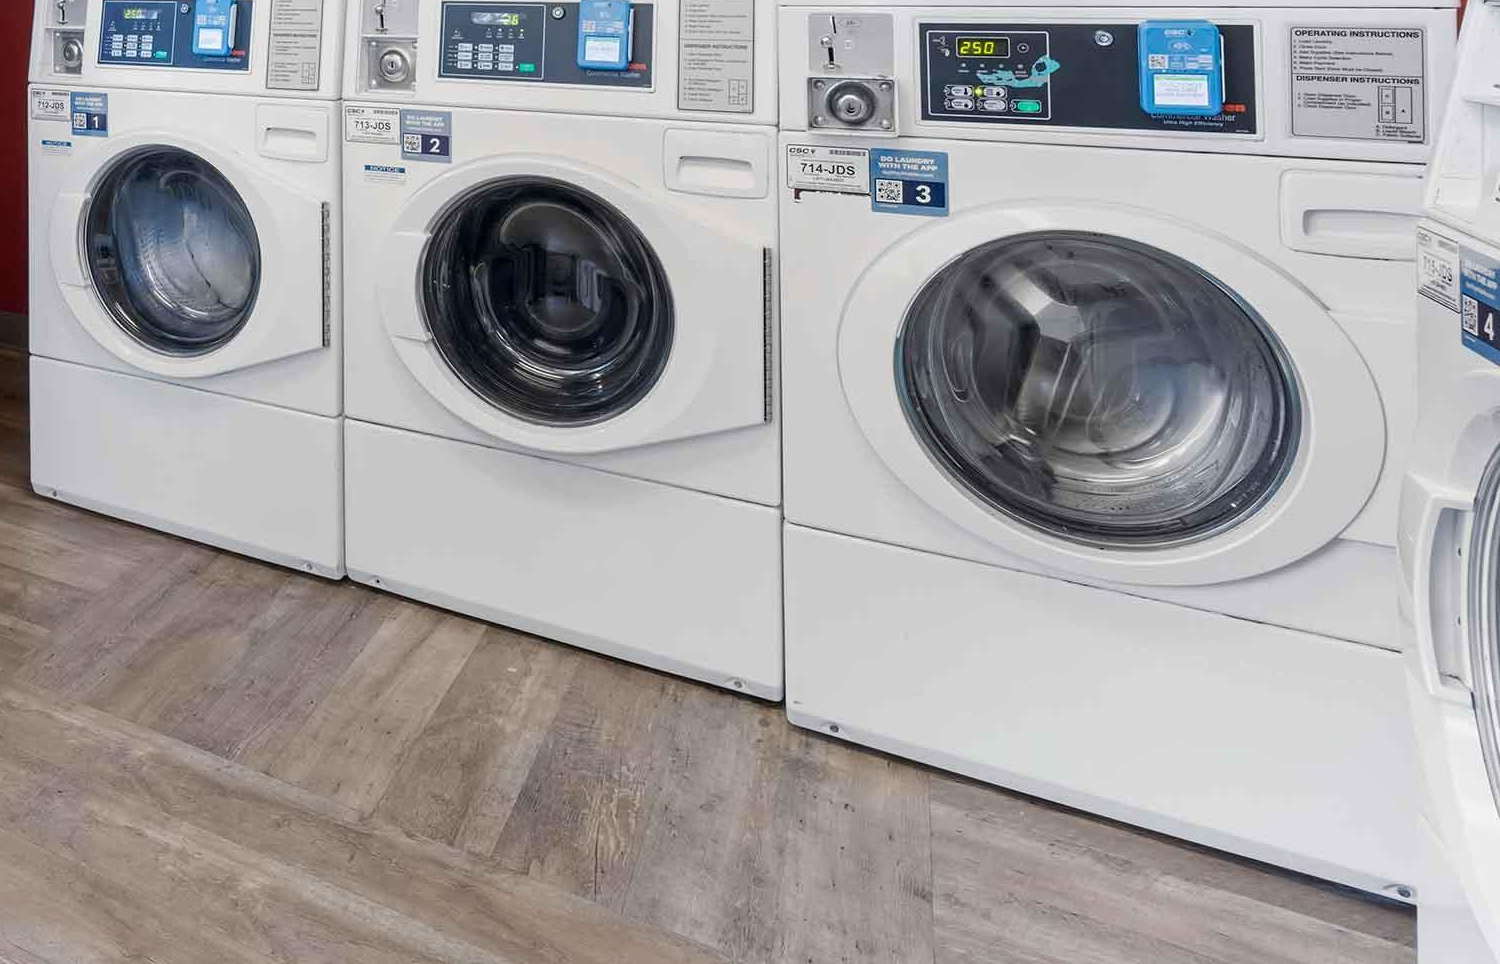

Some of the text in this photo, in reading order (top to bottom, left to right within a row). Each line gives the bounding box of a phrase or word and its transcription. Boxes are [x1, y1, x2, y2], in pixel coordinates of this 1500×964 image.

[1294, 29, 1420, 39] OPERATING INSTRUCTIONS
[960, 41, 995, 55] 250
[1296, 75, 1420, 85] DISPENSER INSTRUCTIONS
[37, 100, 65, 110] 712-JDS
[92, 115, 99, 129] 1
[354, 120, 392, 131] 713-JDS
[429, 137, 441, 153] 2
[880, 155, 936, 165] DO LAUNDRY
[800, 162, 856, 176] 714-JDS
[878, 162, 939, 172] WITH THE APP
[915, 184, 932, 204] 3
[1483, 312, 1496, 341] 4
